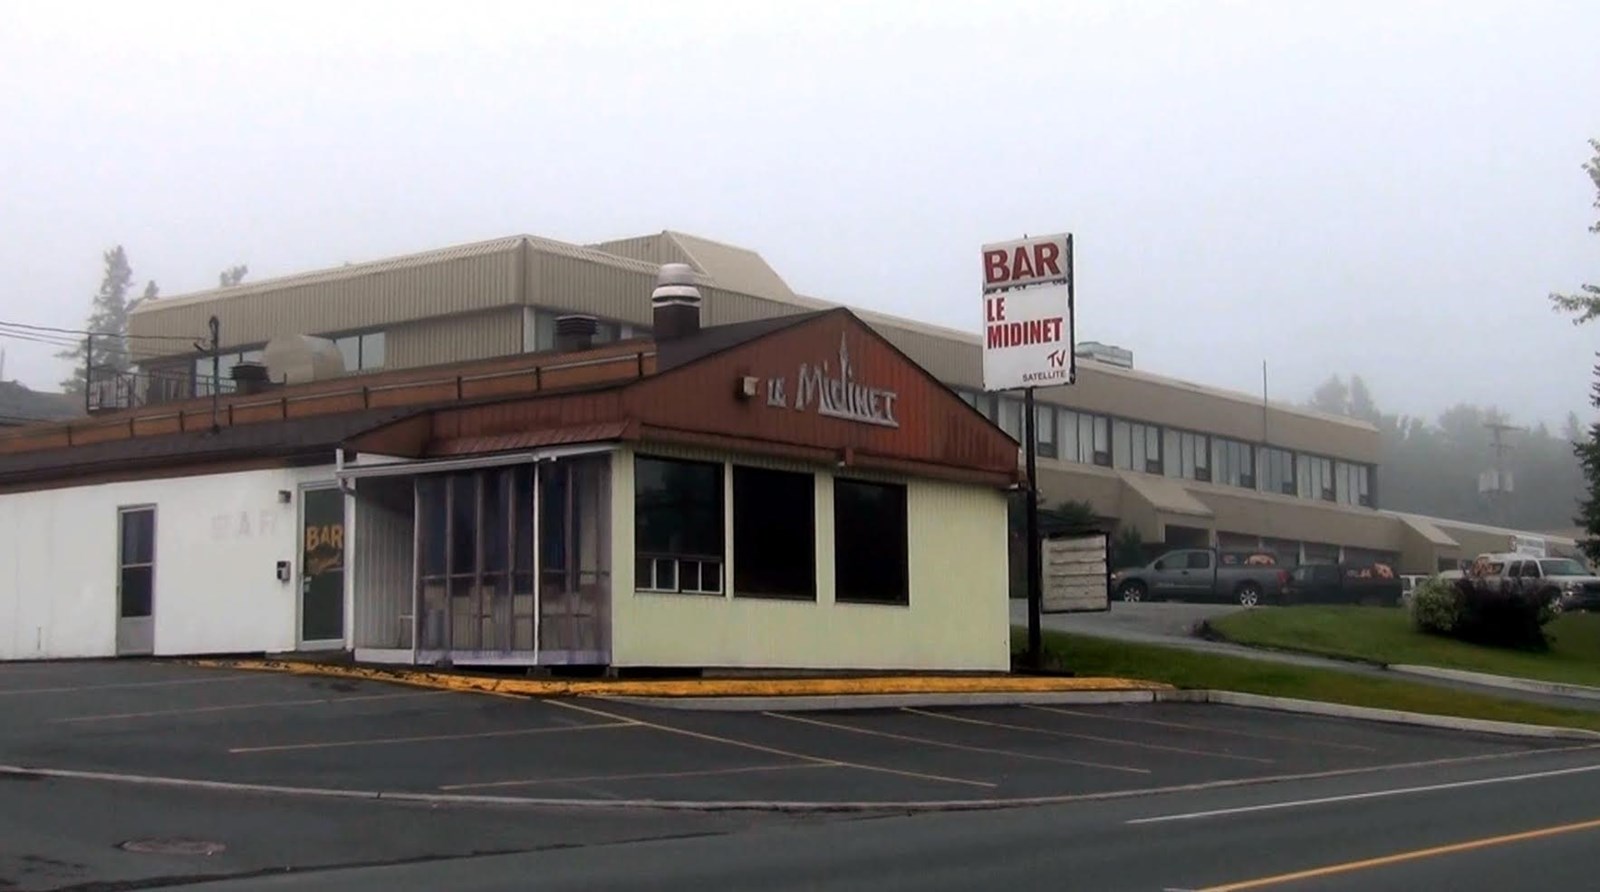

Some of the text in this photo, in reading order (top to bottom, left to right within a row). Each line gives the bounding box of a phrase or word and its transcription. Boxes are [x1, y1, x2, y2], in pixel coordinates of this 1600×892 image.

[984, 243, 1061, 284] BAR
[987, 298, 1005, 322] LE
[988, 318, 1063, 349] MIDINET
[1048, 349, 1066, 368] TV
[1023, 370, 1066, 382] SATELLITE
[306, 524, 343, 551] BAR
